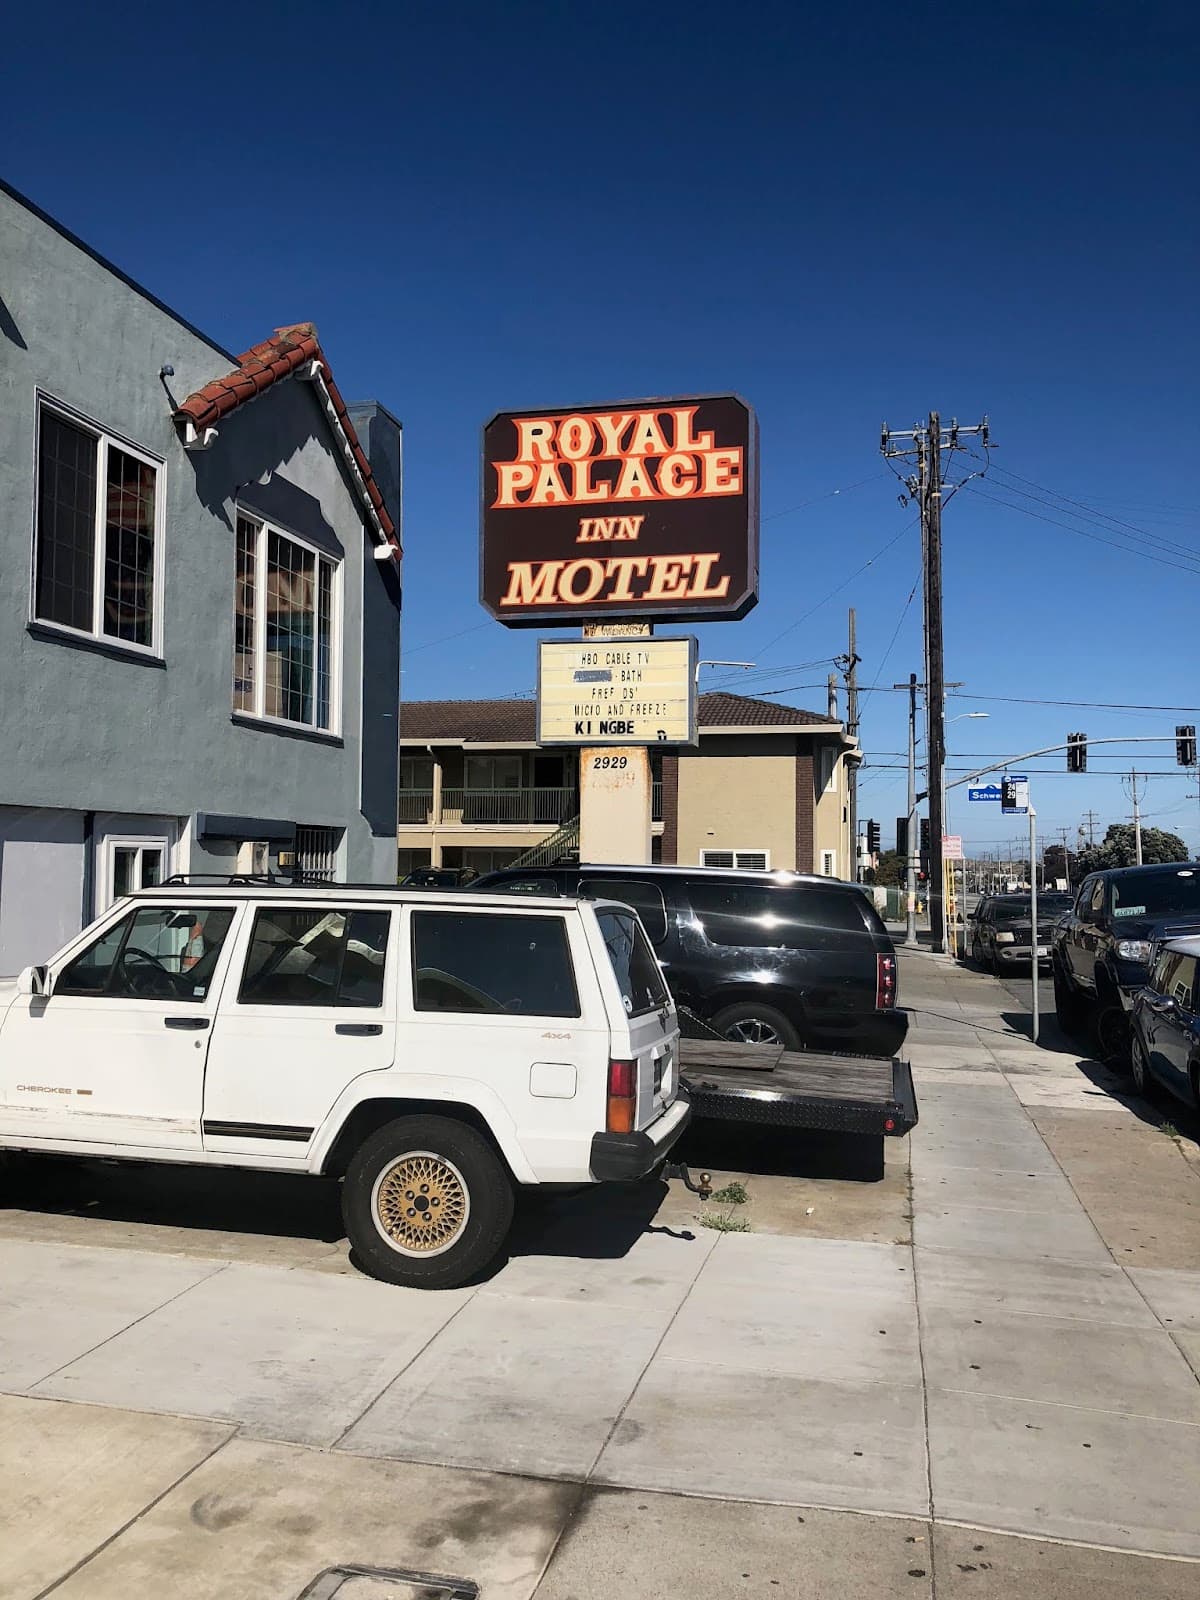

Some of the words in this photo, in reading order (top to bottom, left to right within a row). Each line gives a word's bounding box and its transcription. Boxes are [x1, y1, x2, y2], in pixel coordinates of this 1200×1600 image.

[511, 406, 715, 463] ROYAL
[490, 447, 743, 509] PALACE
[576, 515, 645, 543] INN
[500, 553, 731, 606] MOTEL
[581, 653, 598, 665] HBO
[606, 652, 631, 664] CABLE
[638, 652, 650, 664] TV
[621, 669, 642, 682] BATH
[608, 704, 624, 716] AND
[593, 756, 628, 769] 2929
[1007, 783, 1016, 791] 24
[1007, 791, 1016, 799] 29
[16, 1084, 73, 1095] CHEROKEE
